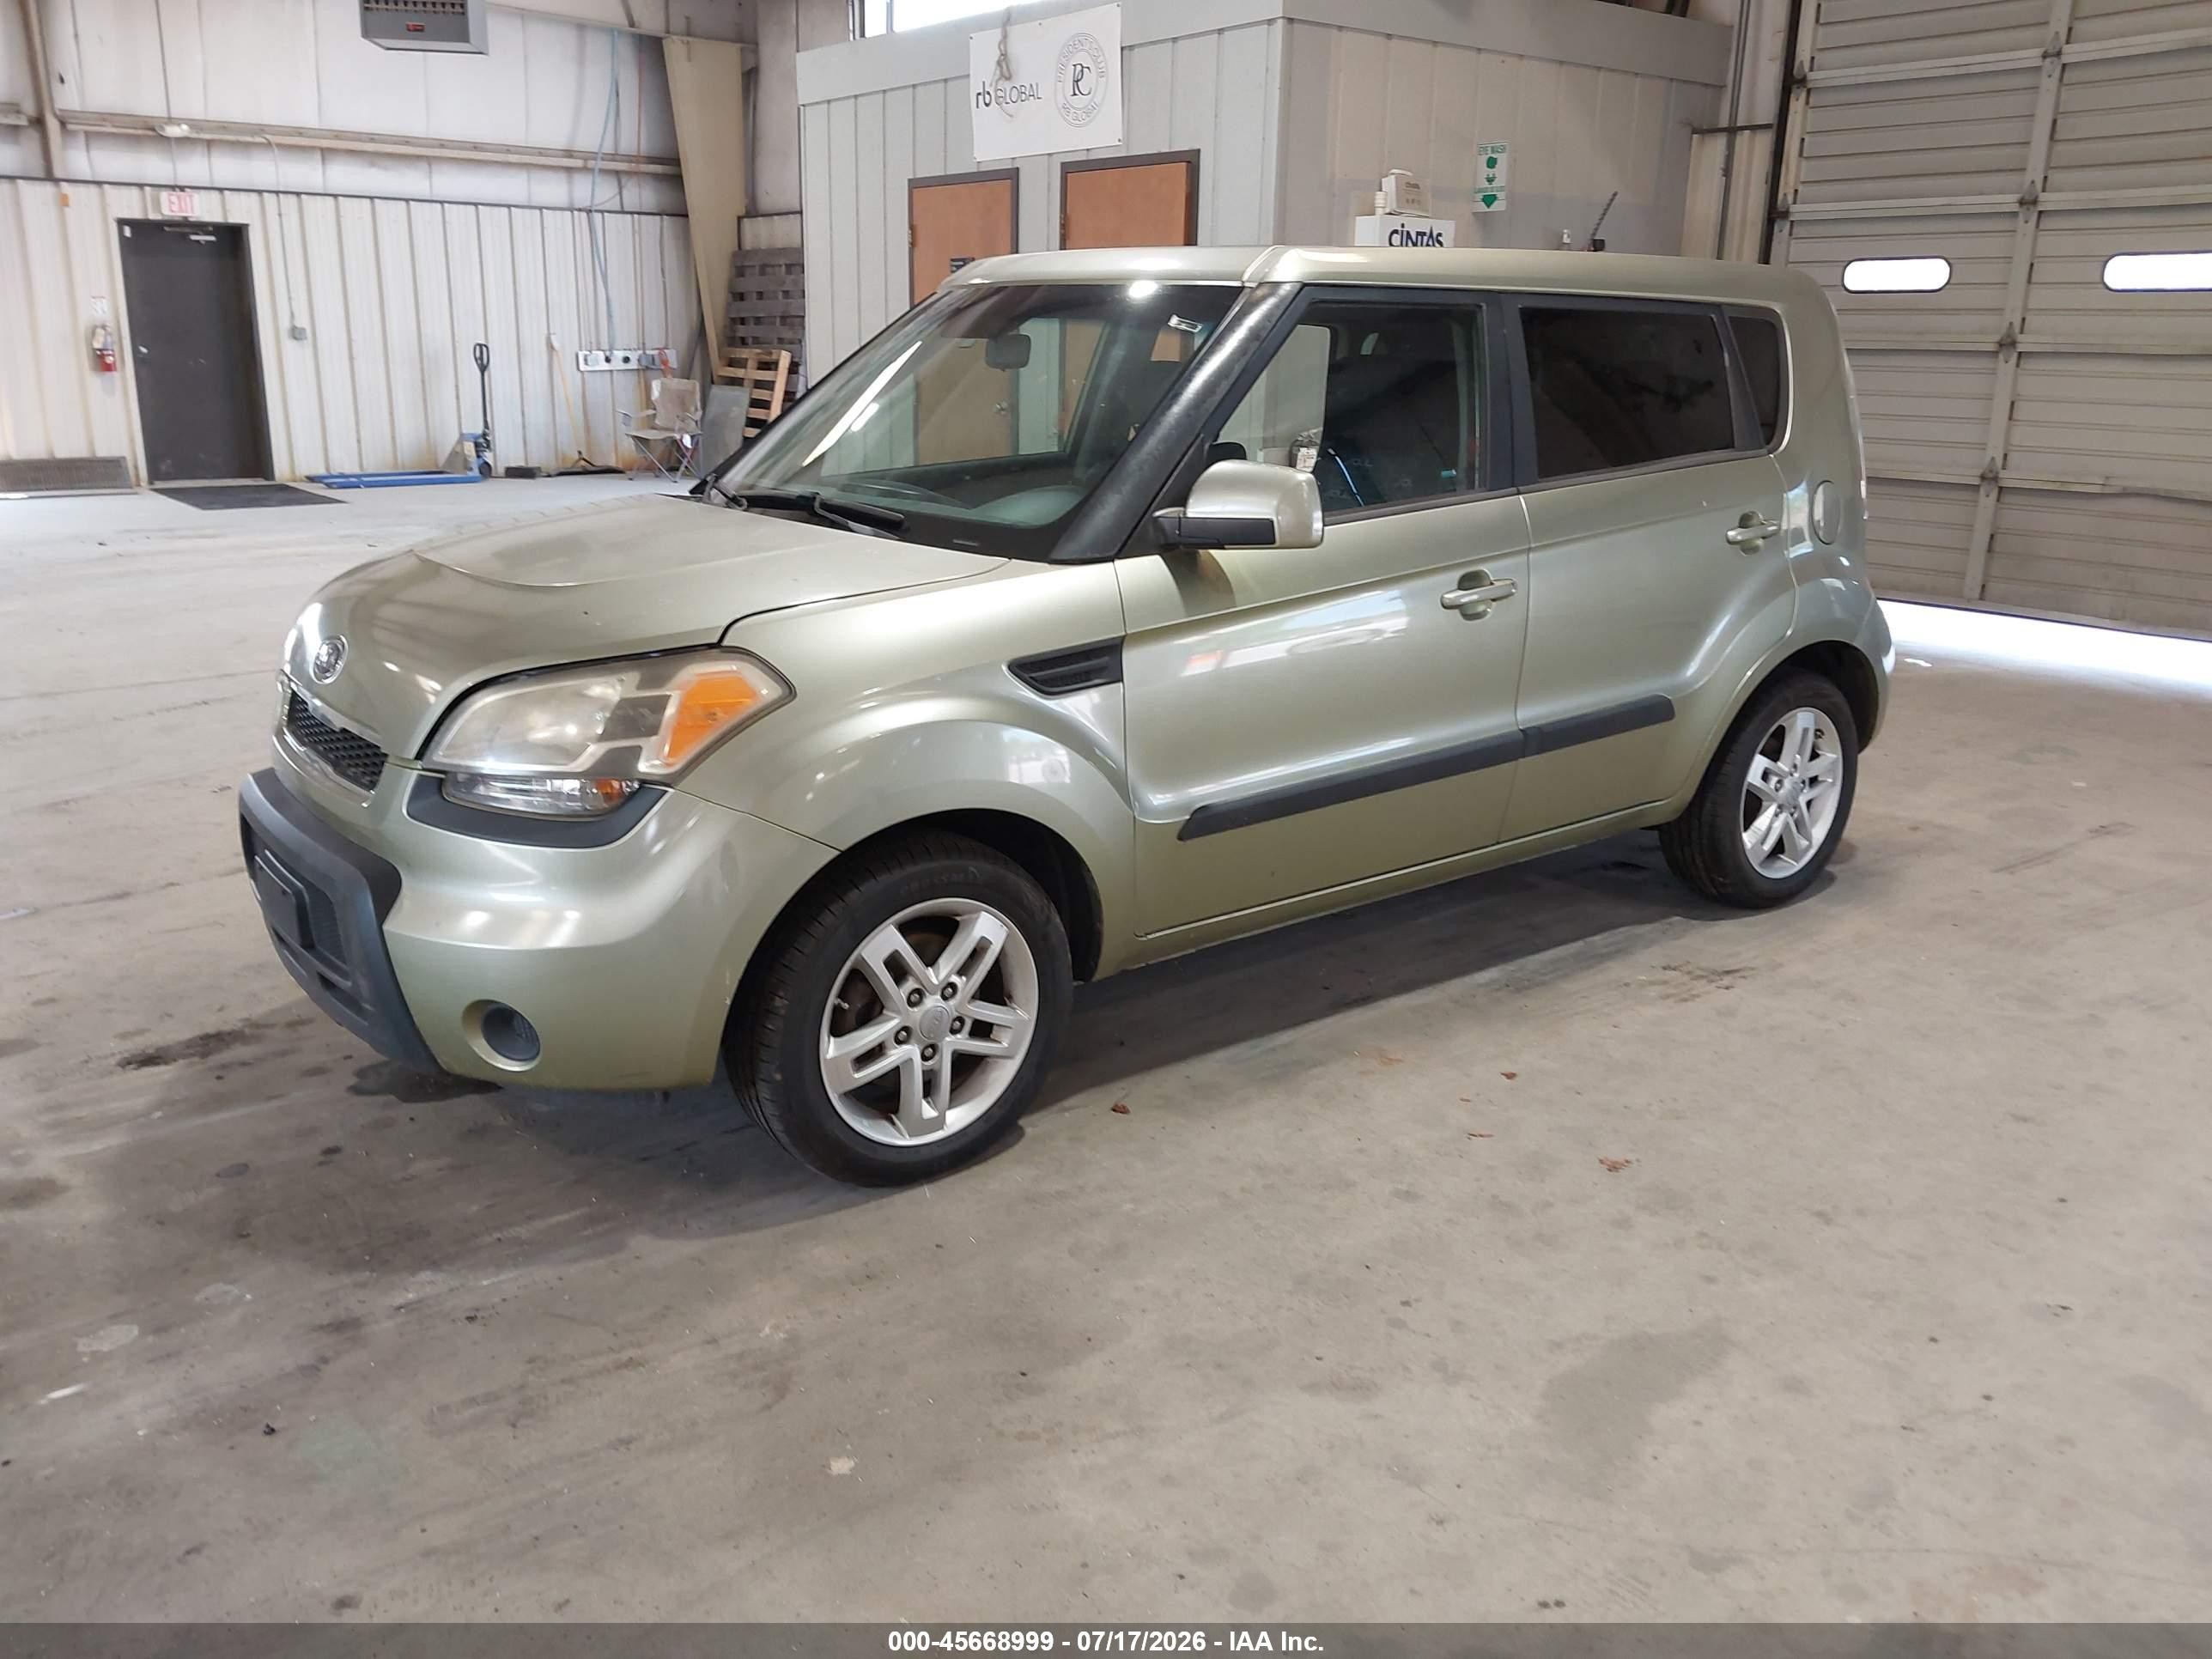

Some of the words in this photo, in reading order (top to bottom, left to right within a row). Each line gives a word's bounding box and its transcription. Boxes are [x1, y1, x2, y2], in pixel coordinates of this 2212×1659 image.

[976, 81, 992, 109] rb
[995, 82, 1042, 106] GLOBAL
[167, 191, 195, 215] EXIT
